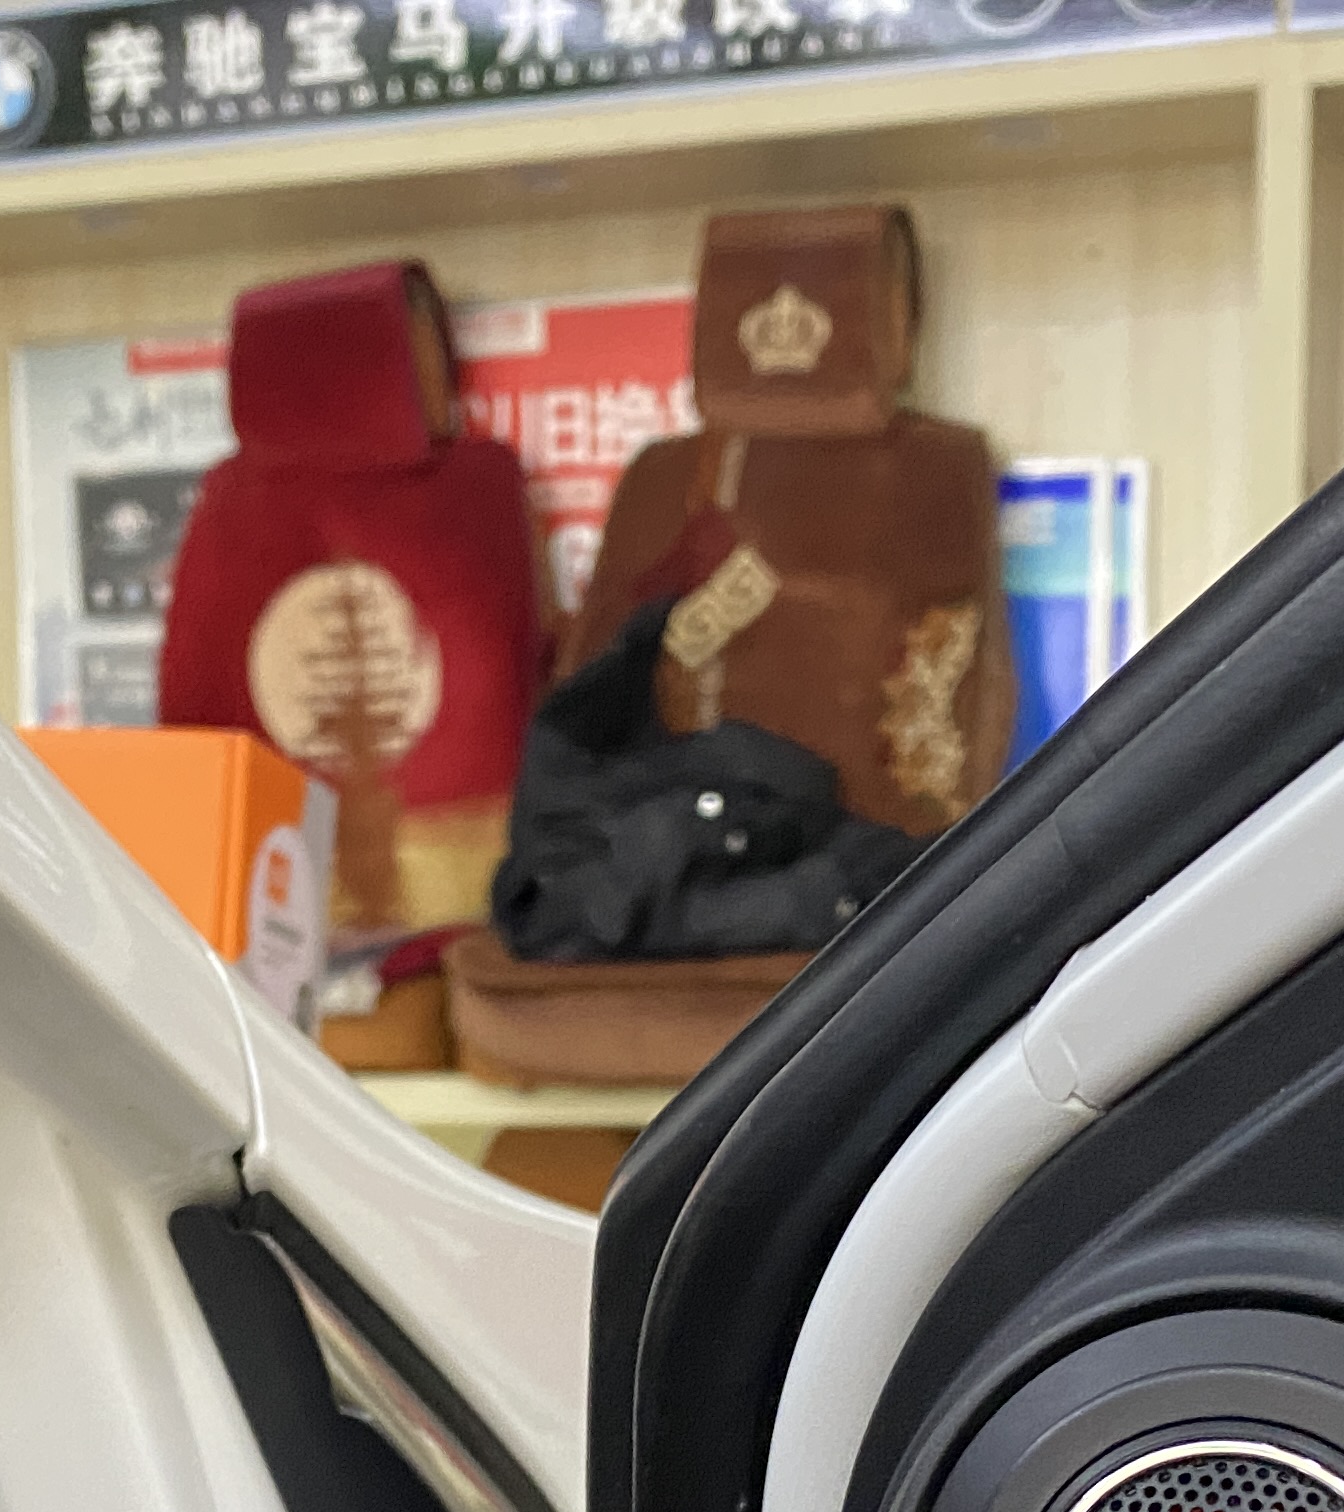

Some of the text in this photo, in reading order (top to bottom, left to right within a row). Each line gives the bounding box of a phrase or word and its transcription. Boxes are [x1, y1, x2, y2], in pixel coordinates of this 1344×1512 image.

[82, 0, 912, 103] 奔驰宝马升级
